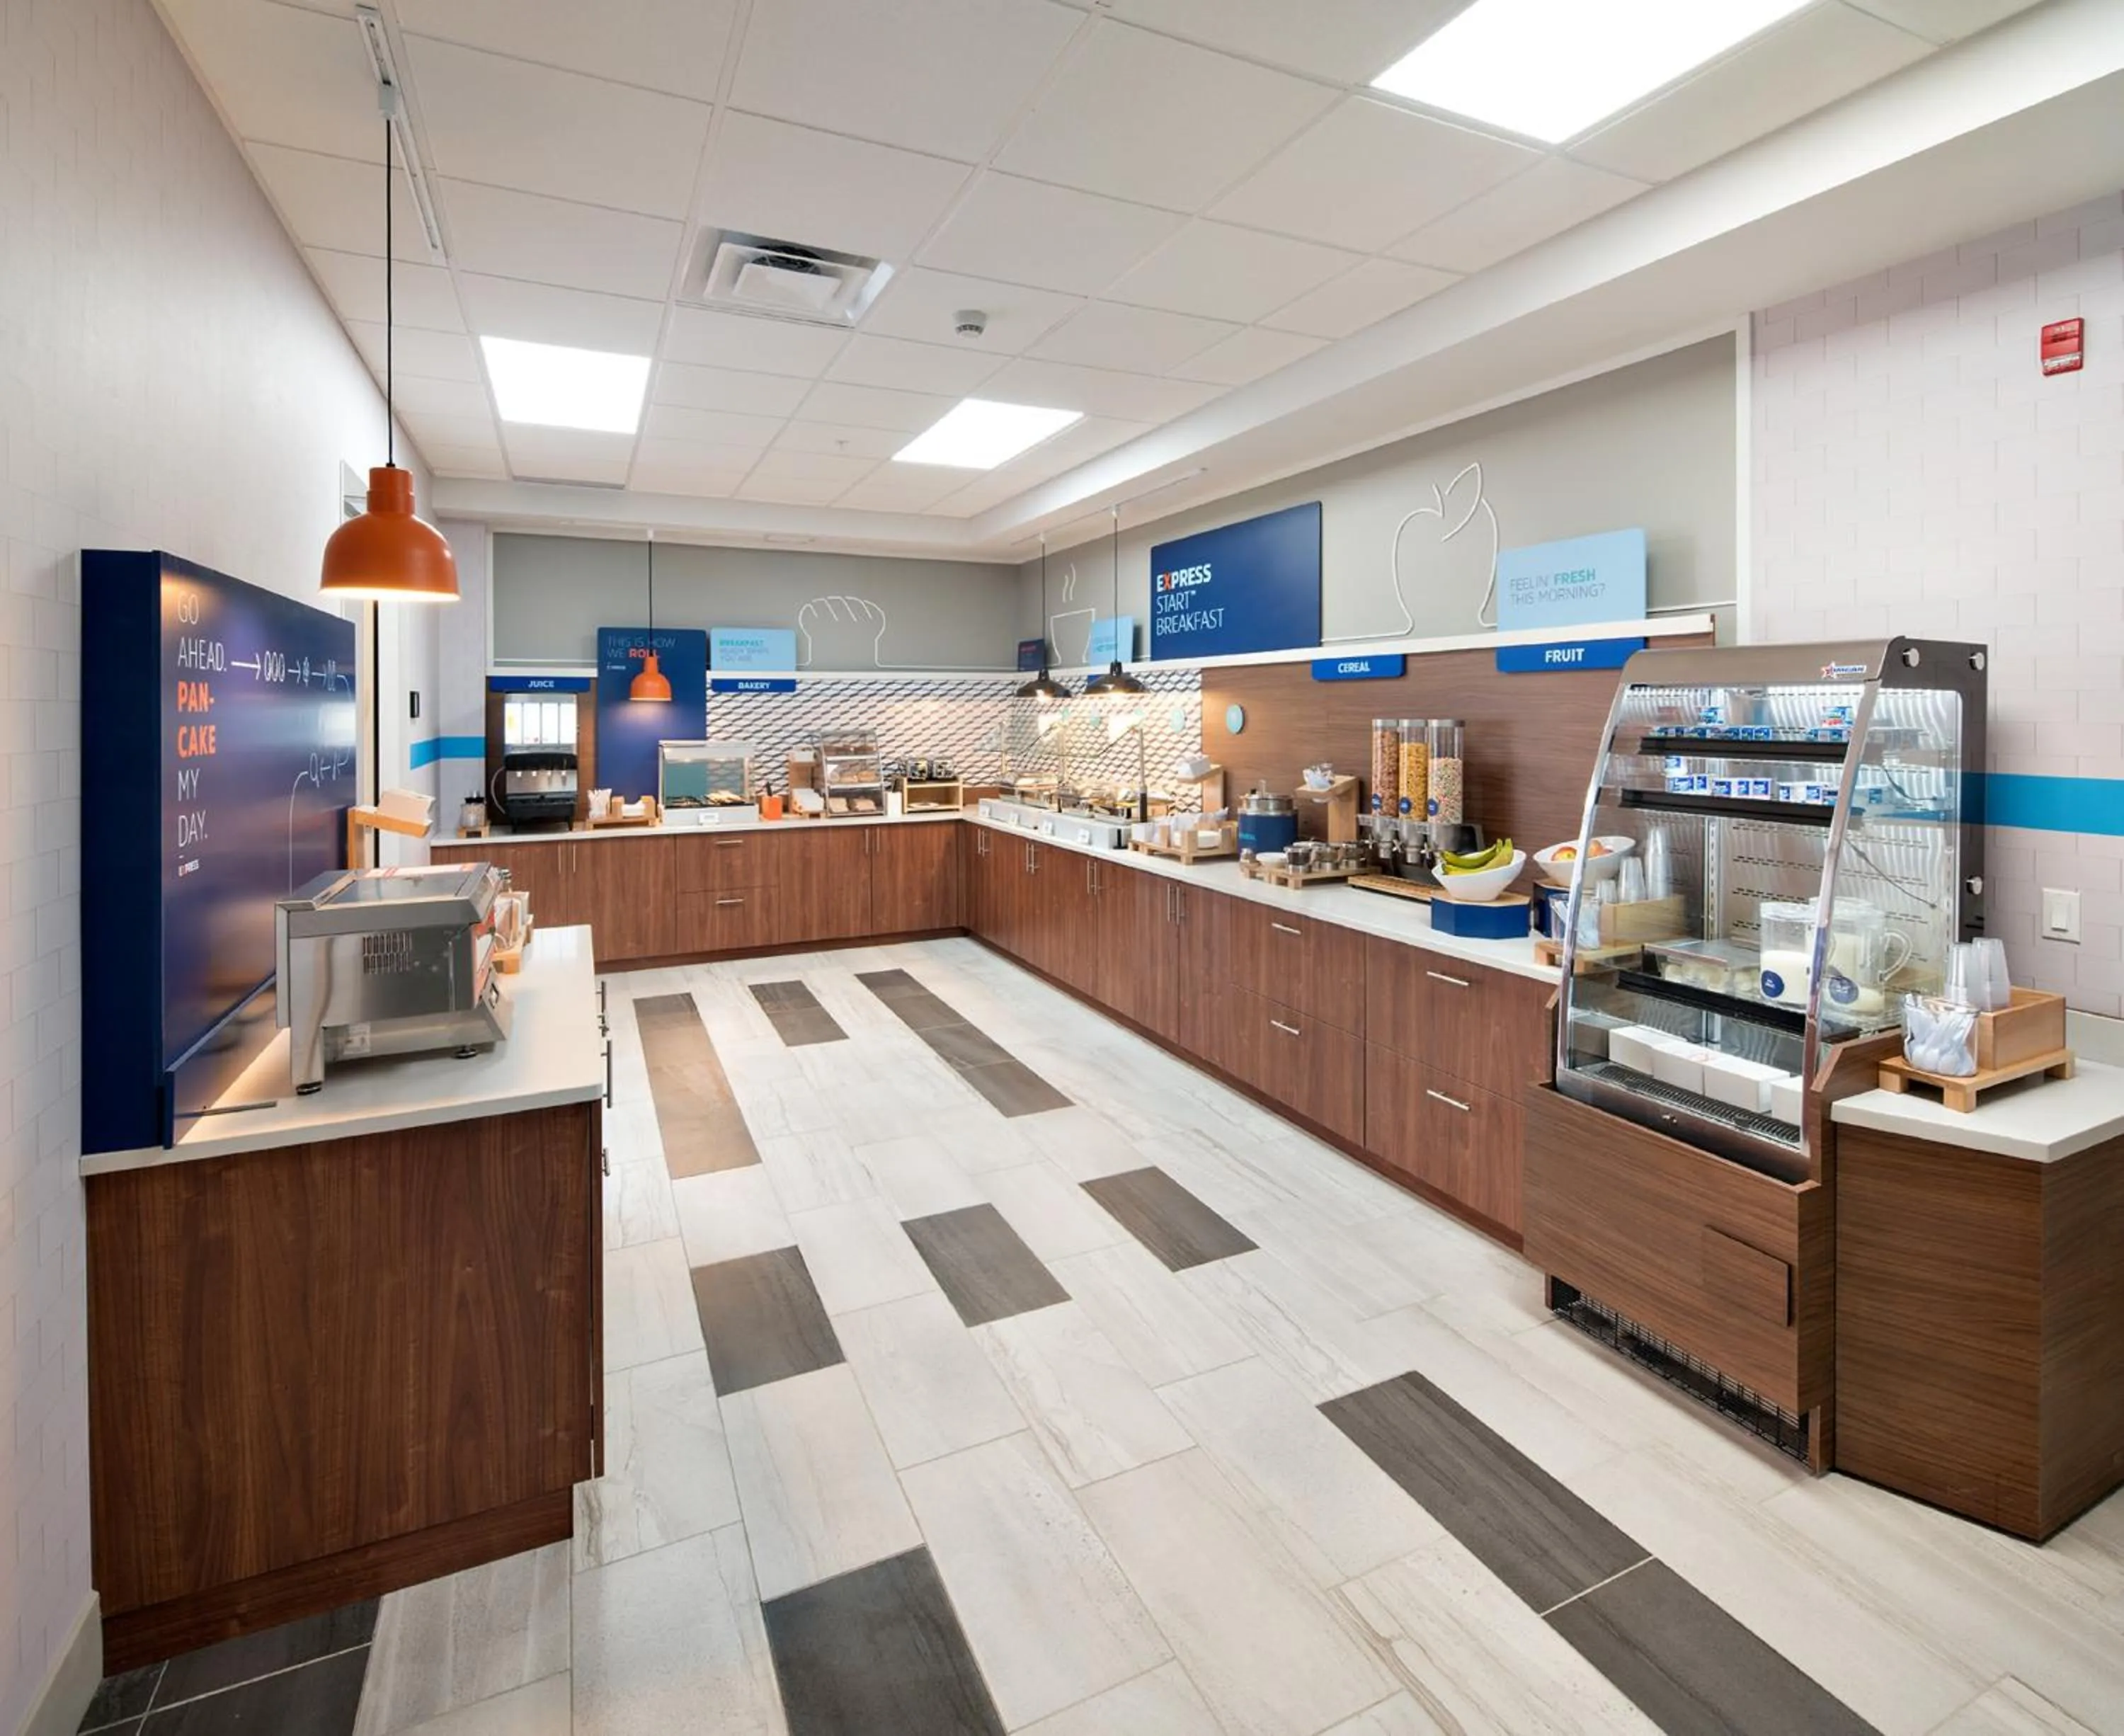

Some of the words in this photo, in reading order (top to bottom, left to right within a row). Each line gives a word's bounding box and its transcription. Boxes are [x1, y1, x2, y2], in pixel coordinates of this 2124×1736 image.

[1157, 563, 1211, 593] EXPRESS
[1554, 569, 1596, 586] FRESH
[178, 590, 199, 624] GO
[1509, 591, 1534, 605] THIS
[1538, 583, 1606, 602] MORNING?
[1156, 607, 1224, 636] BREAKFAST
[178, 636, 227, 672] AHEAD.
[1337, 660, 1371, 674] CEREAL
[1545, 648, 1585, 663] FRUIT
[178, 680, 215, 713] PAN-
[178, 724, 216, 758] CAKE
[178, 767, 200, 801] MY
[178, 809, 208, 847] DAY.
